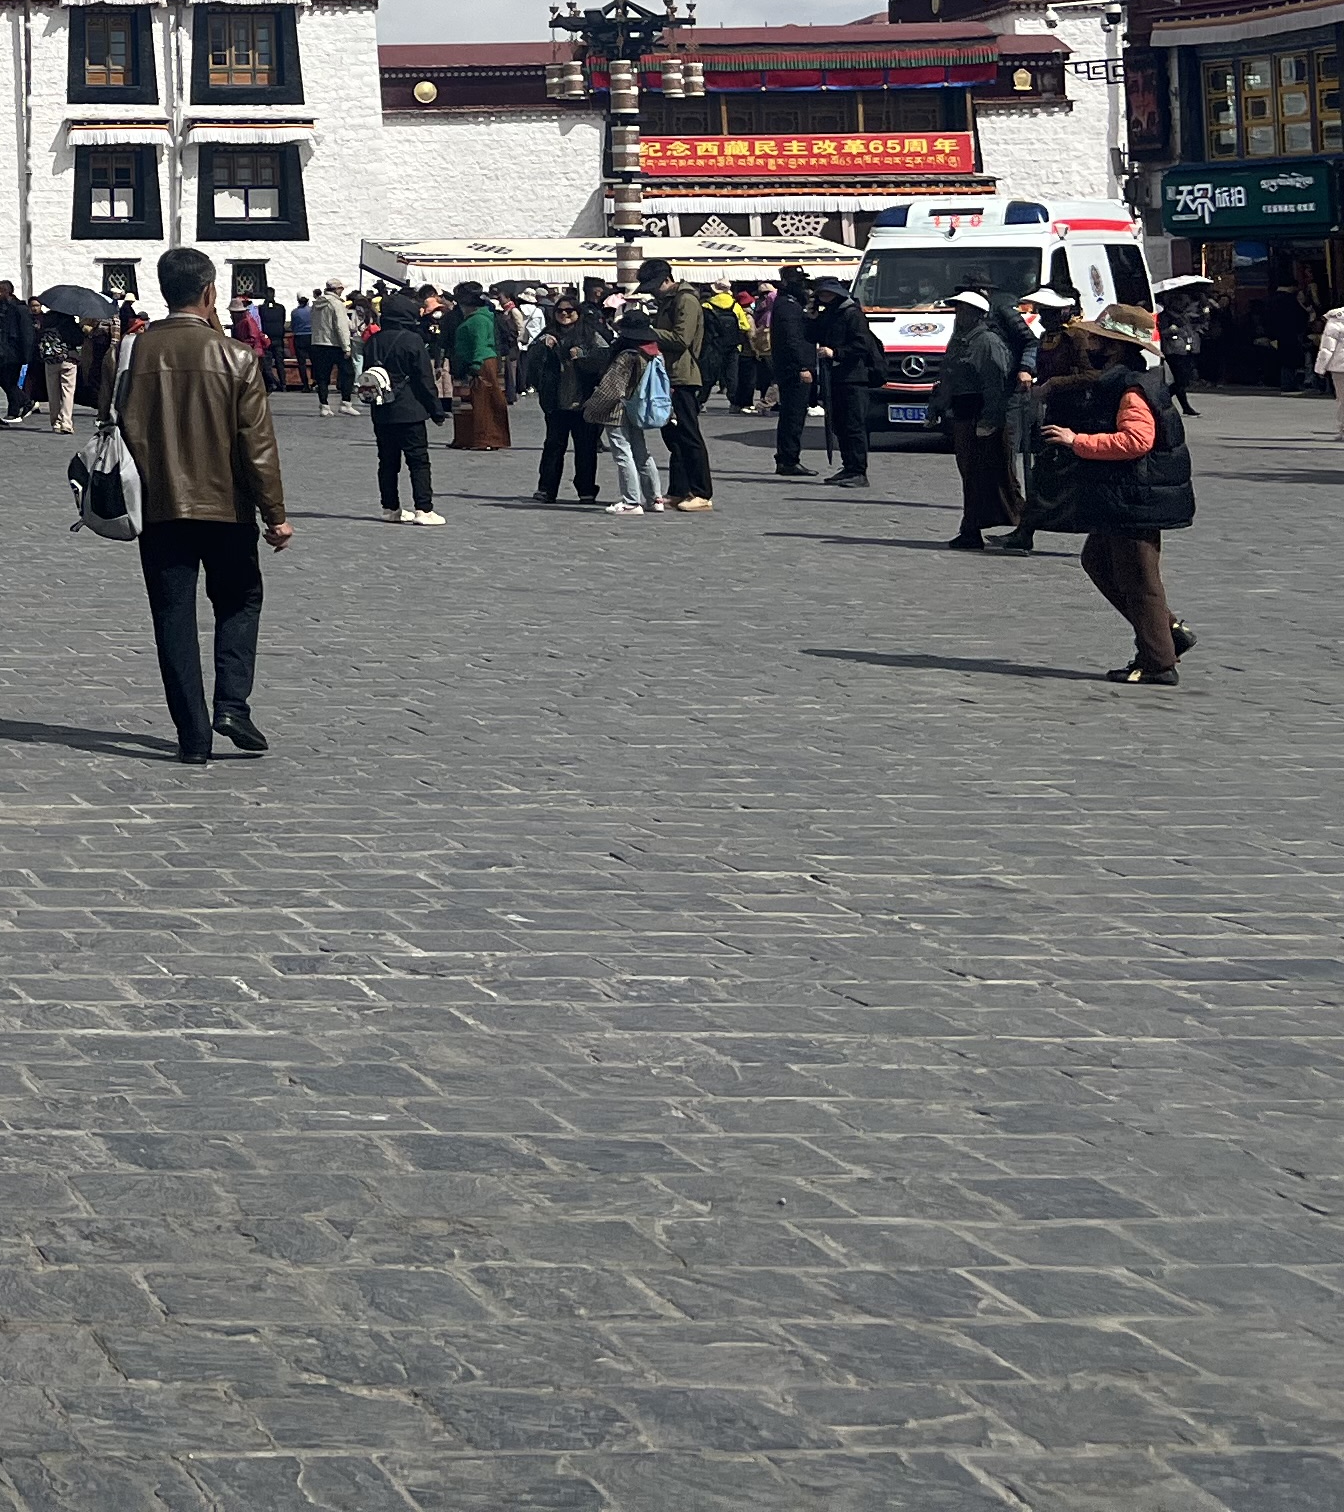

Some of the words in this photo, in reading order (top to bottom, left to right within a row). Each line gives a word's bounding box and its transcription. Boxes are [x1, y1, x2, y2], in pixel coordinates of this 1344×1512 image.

[639, 138, 960, 156] 纪念西藏民主改革65周年
